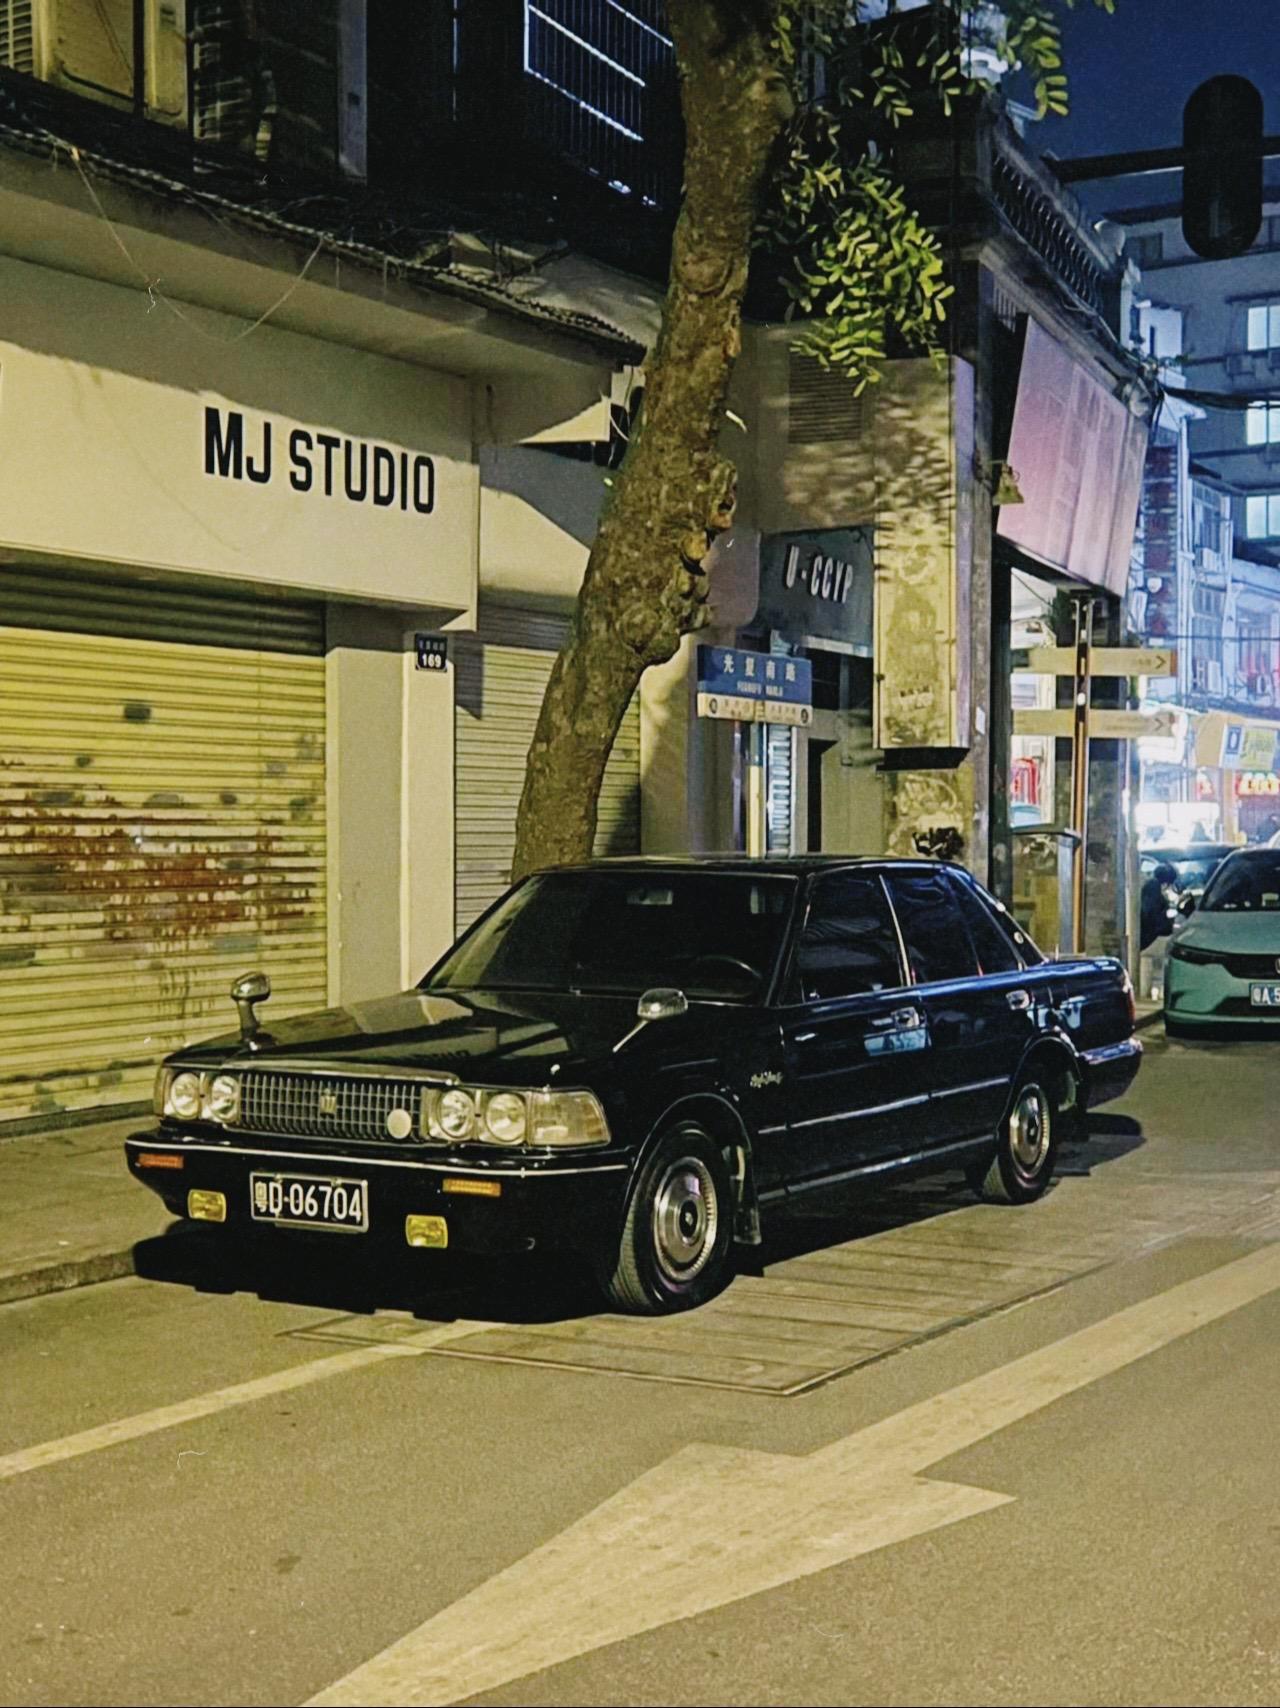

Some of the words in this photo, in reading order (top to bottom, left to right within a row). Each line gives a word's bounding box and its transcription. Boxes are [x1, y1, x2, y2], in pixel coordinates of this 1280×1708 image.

[205, 407, 271, 483] MJ
[289, 429, 434, 514] STUDIO
[422, 653, 441, 668] 169
